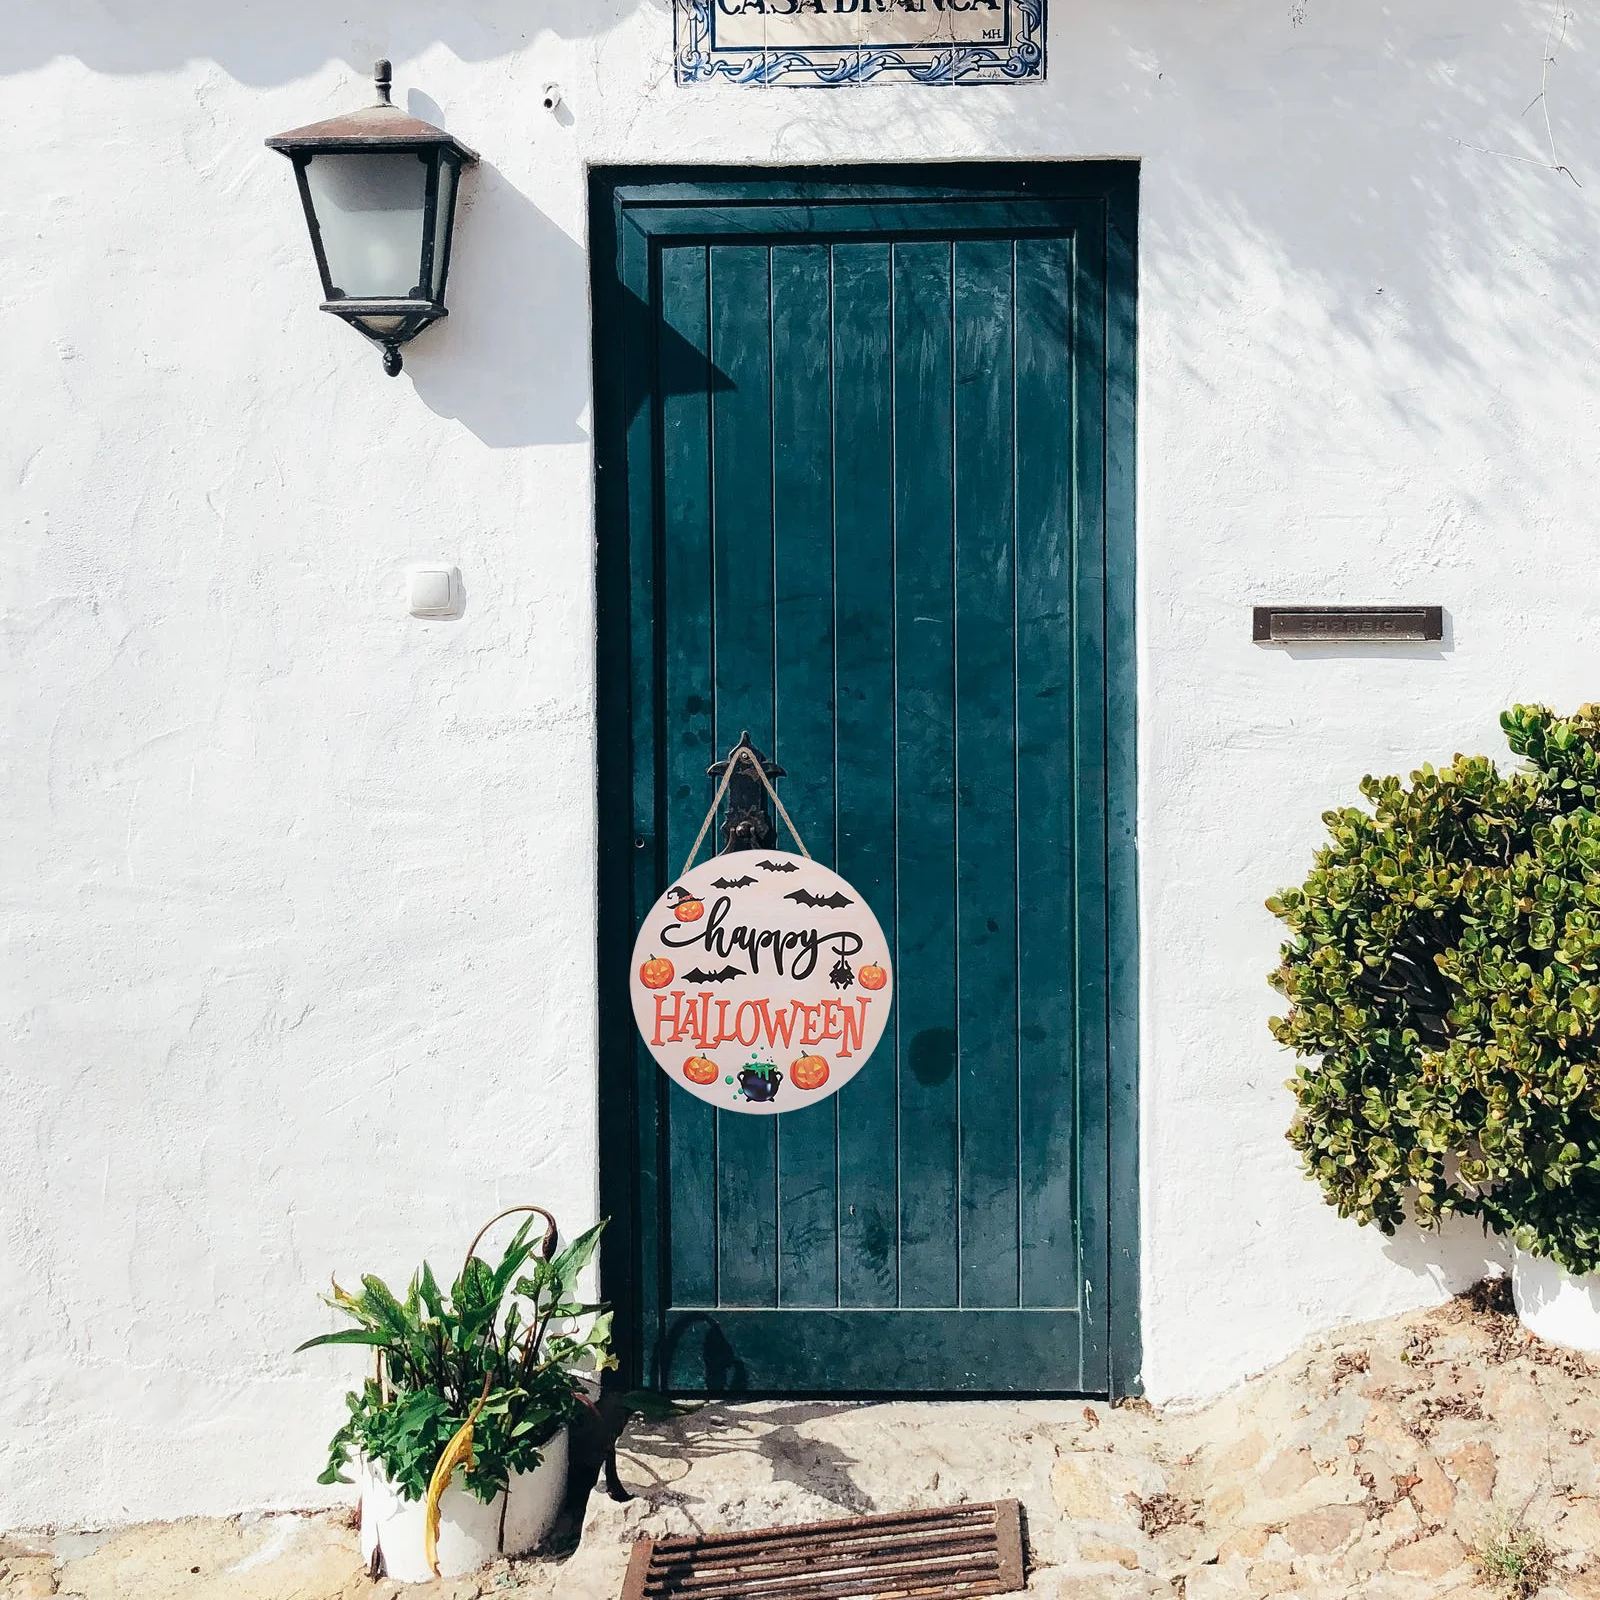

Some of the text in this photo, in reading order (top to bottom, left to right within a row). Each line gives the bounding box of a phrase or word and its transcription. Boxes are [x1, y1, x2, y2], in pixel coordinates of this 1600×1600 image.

[982, 28, 1003, 39] MH
[660, 896, 863, 980] happy
[650, 991, 872, 1058] HALLOWEEN
